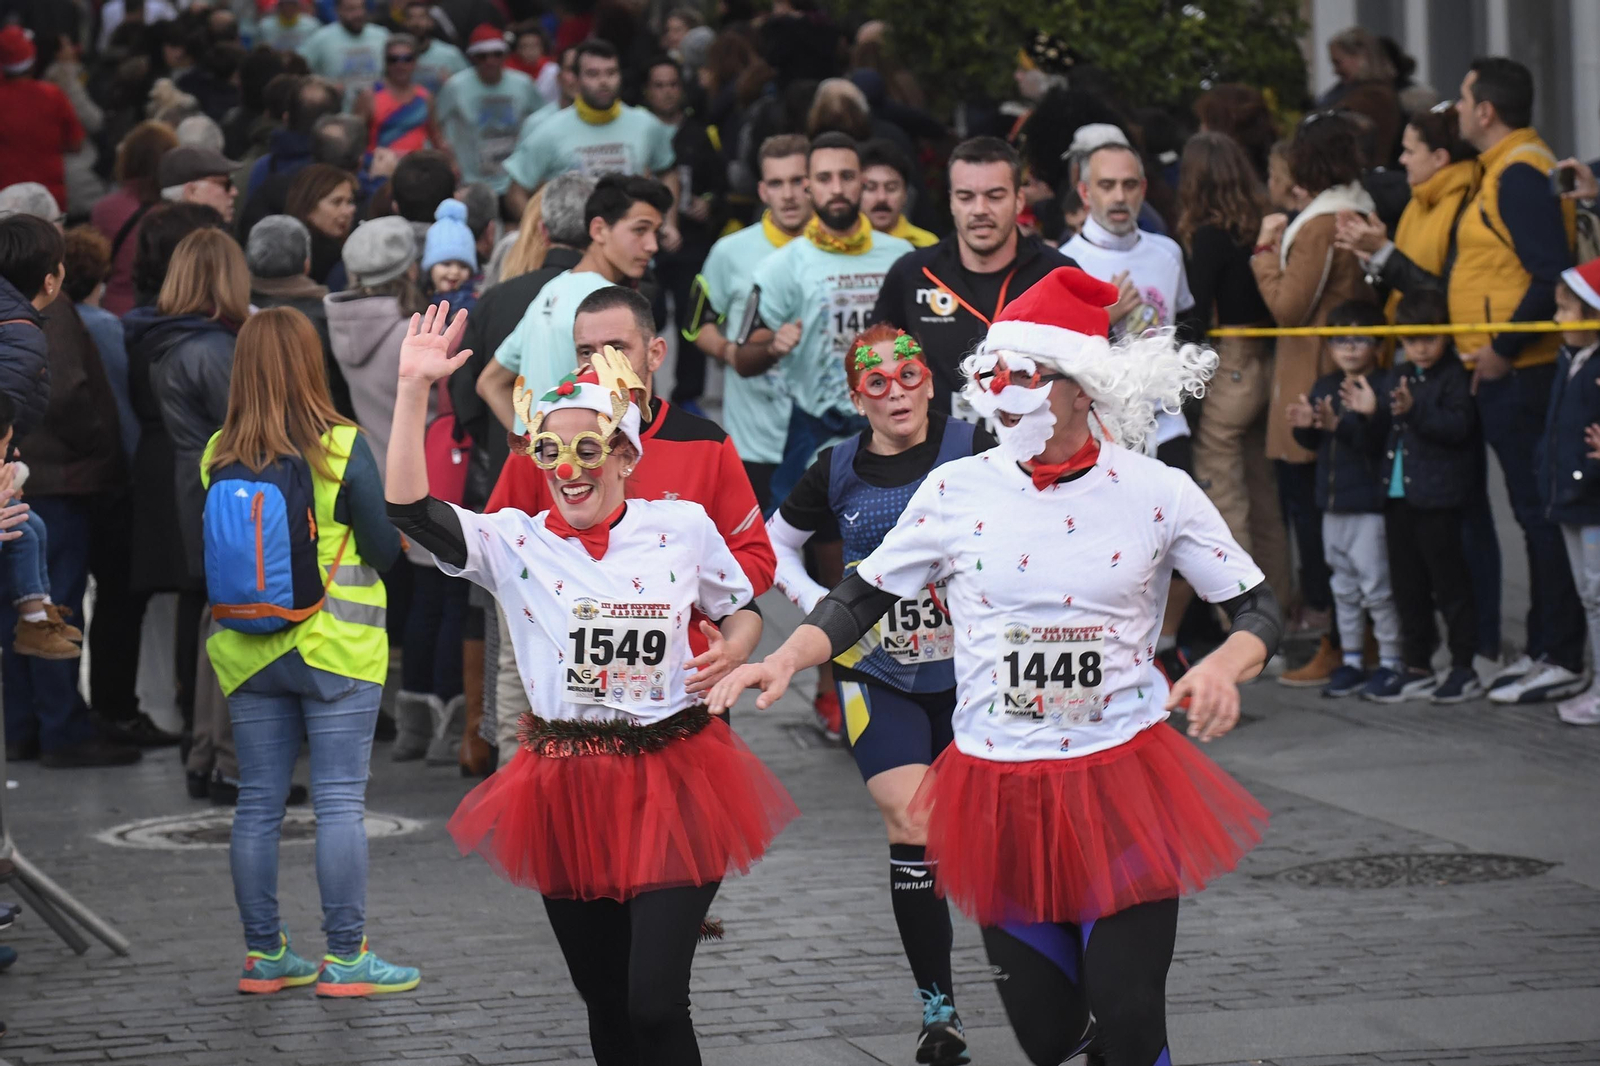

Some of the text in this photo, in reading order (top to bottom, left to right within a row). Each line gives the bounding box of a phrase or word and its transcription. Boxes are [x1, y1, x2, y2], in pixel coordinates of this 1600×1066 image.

[569, 627, 667, 666] 1549
[1003, 651, 1102, 689] 1448
[894, 880, 933, 890] SPORTLAST
